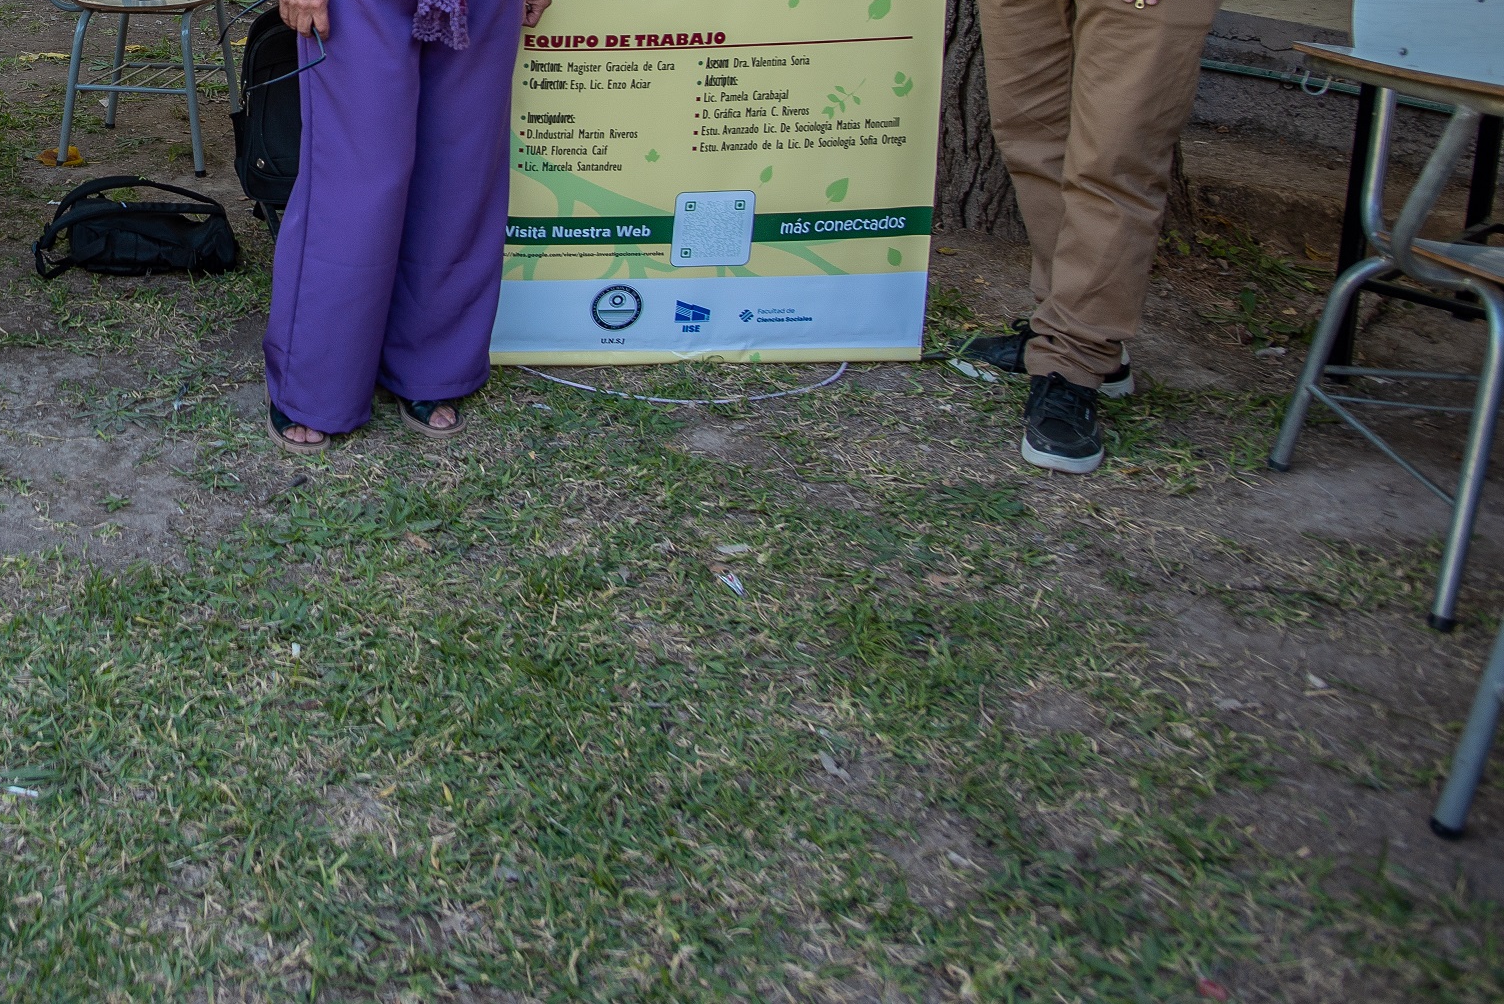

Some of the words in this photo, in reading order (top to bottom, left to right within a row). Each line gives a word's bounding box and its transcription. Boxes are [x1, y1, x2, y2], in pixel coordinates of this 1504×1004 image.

[524, 34, 598, 47] EQUIPO
[605, 35, 631, 47] DE
[635, 32, 726, 46] TRABAJO
[568, 62, 601, 75] Magister
[606, 61, 639, 72] Graciela
[643, 61, 652, 71] de
[657, 61, 675, 71] Cara
[610, 129, 638, 139] Riveros
[505, 225, 546, 239] Visitá
[552, 226, 611, 239] Nuestra
[616, 225, 651, 238] Web
[780, 218, 811, 235] más
